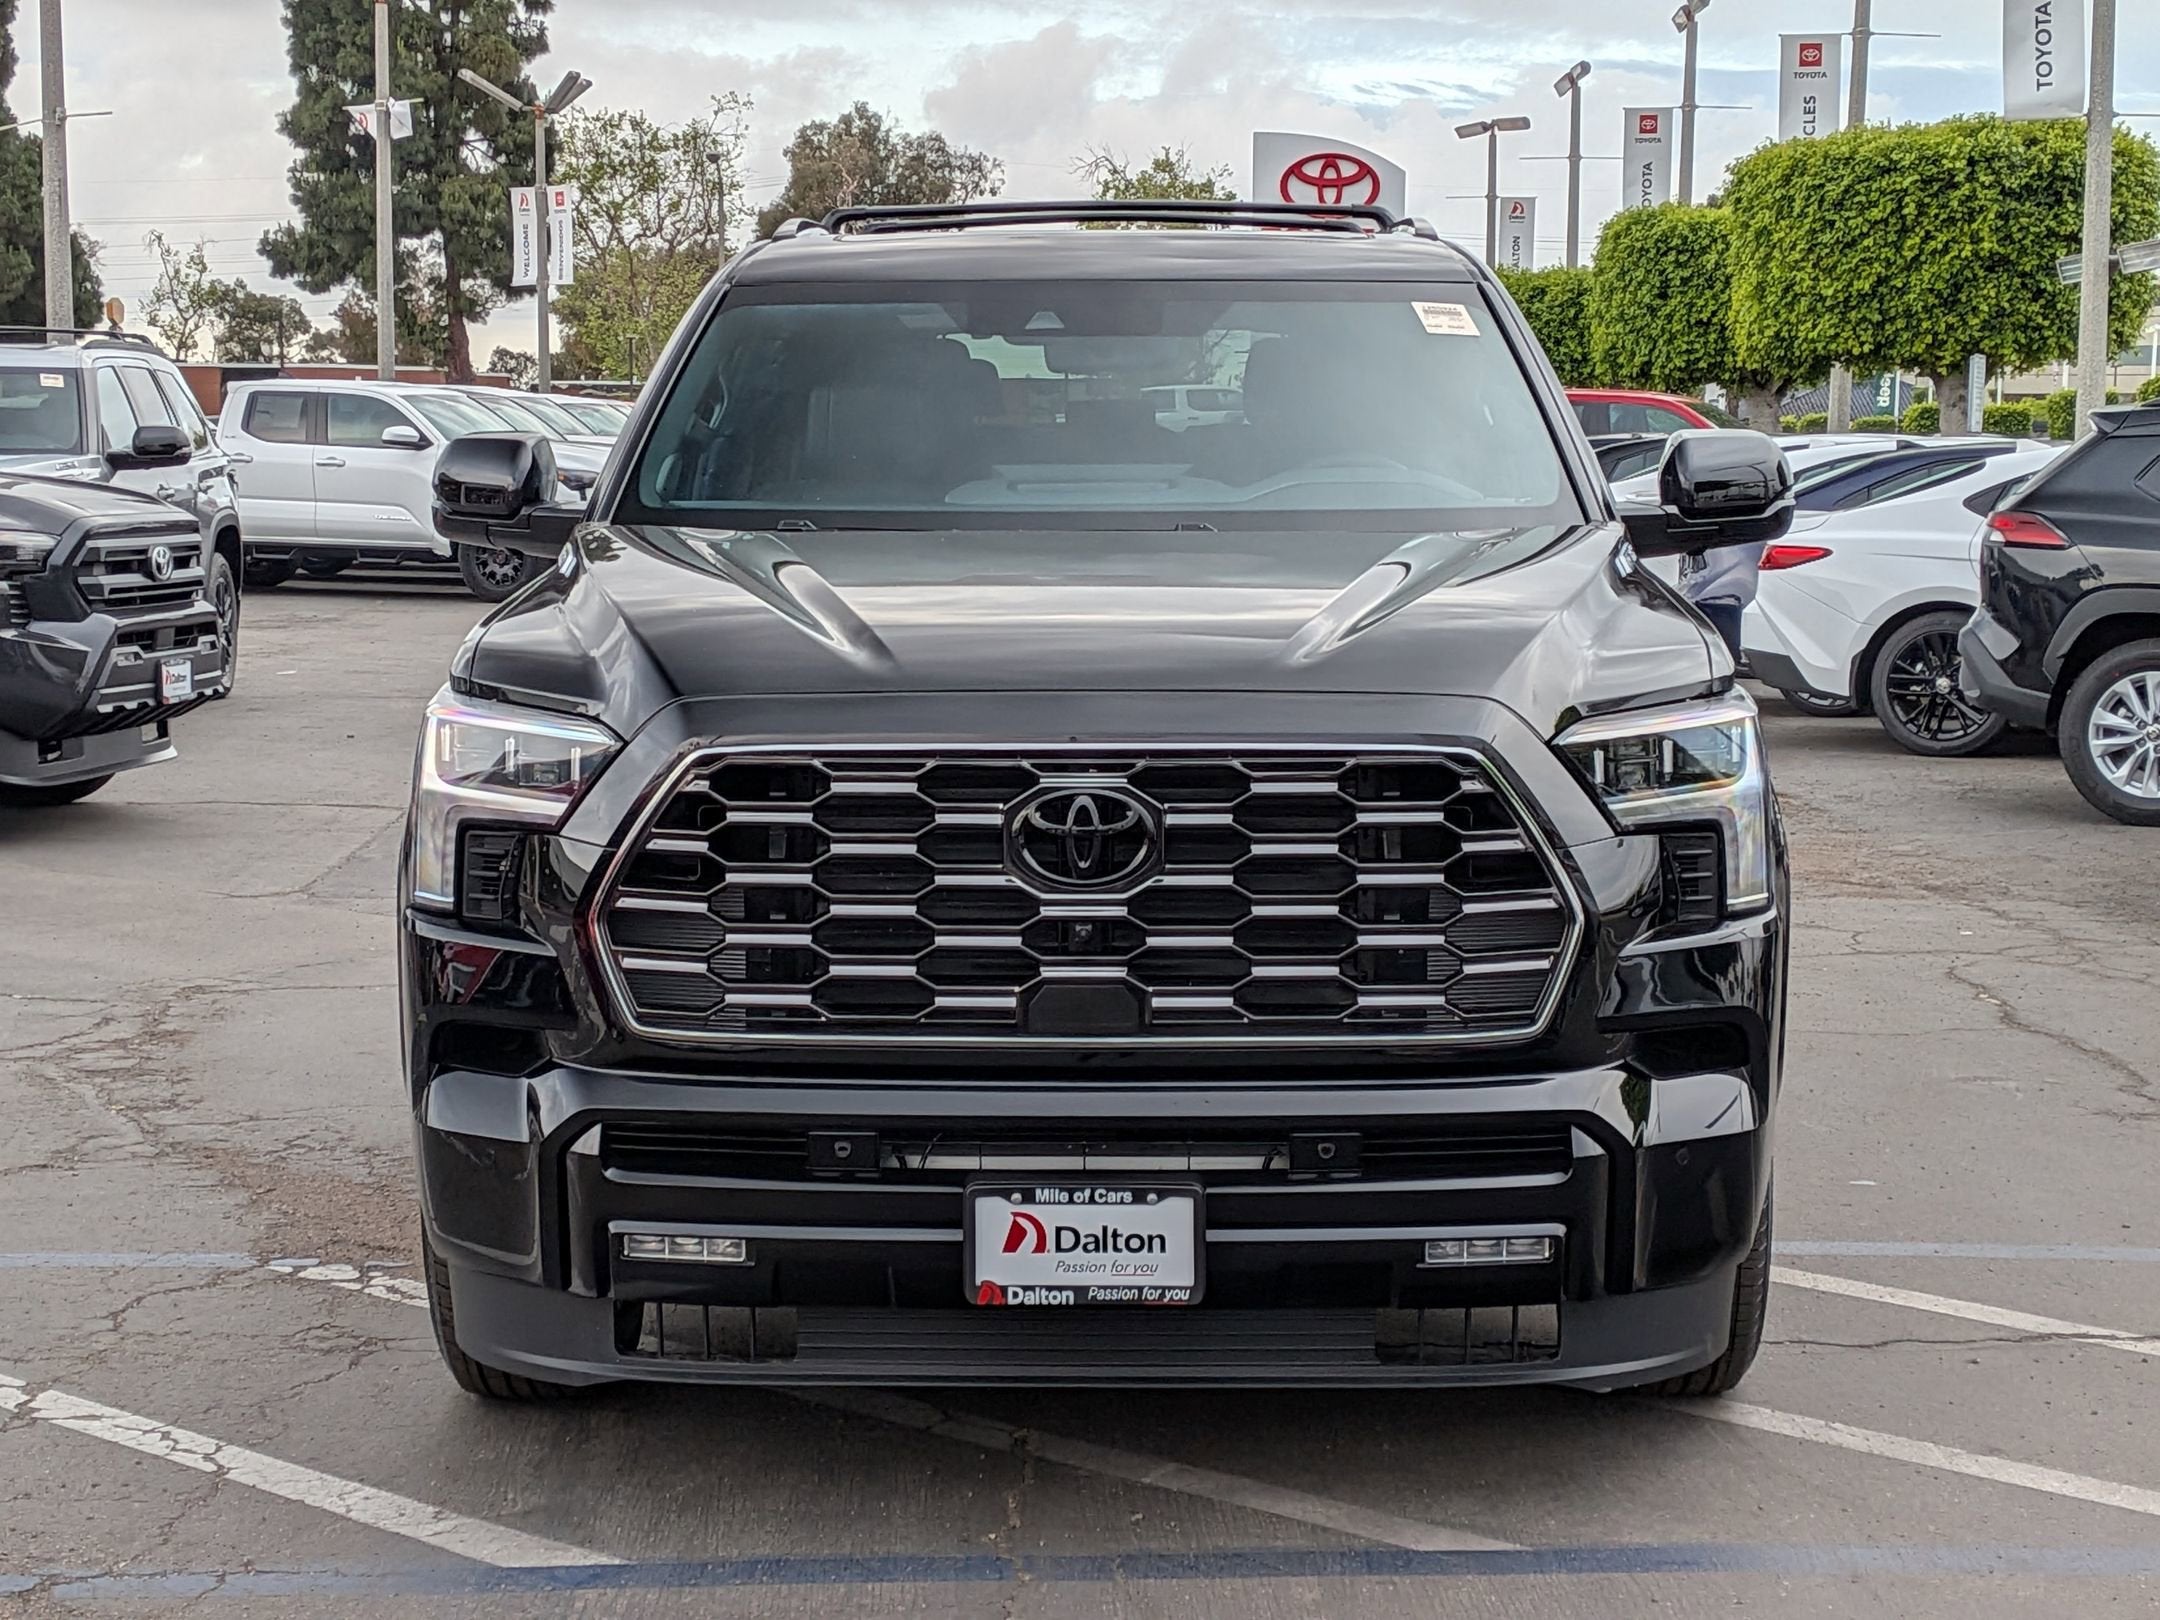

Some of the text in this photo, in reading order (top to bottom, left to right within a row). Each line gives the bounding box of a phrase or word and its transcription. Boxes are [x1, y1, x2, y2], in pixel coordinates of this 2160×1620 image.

[2035, 1, 2053, 92] TOYOTA
[1793, 71, 1828, 79] TOYOTA
[1803, 95, 1816, 140] CLES
[1641, 161, 1653, 208] OYOTA
[522, 223, 530, 278] WELCOME
[1035, 1188, 1133, 1203] Mile of Cars
[1055, 1225, 1166, 1254] Dalton
[1055, 1260, 1159, 1275] Passion for you
[1007, 1286, 1075, 1305] Dalton
[1088, 1287, 1190, 1303] Passion for you
